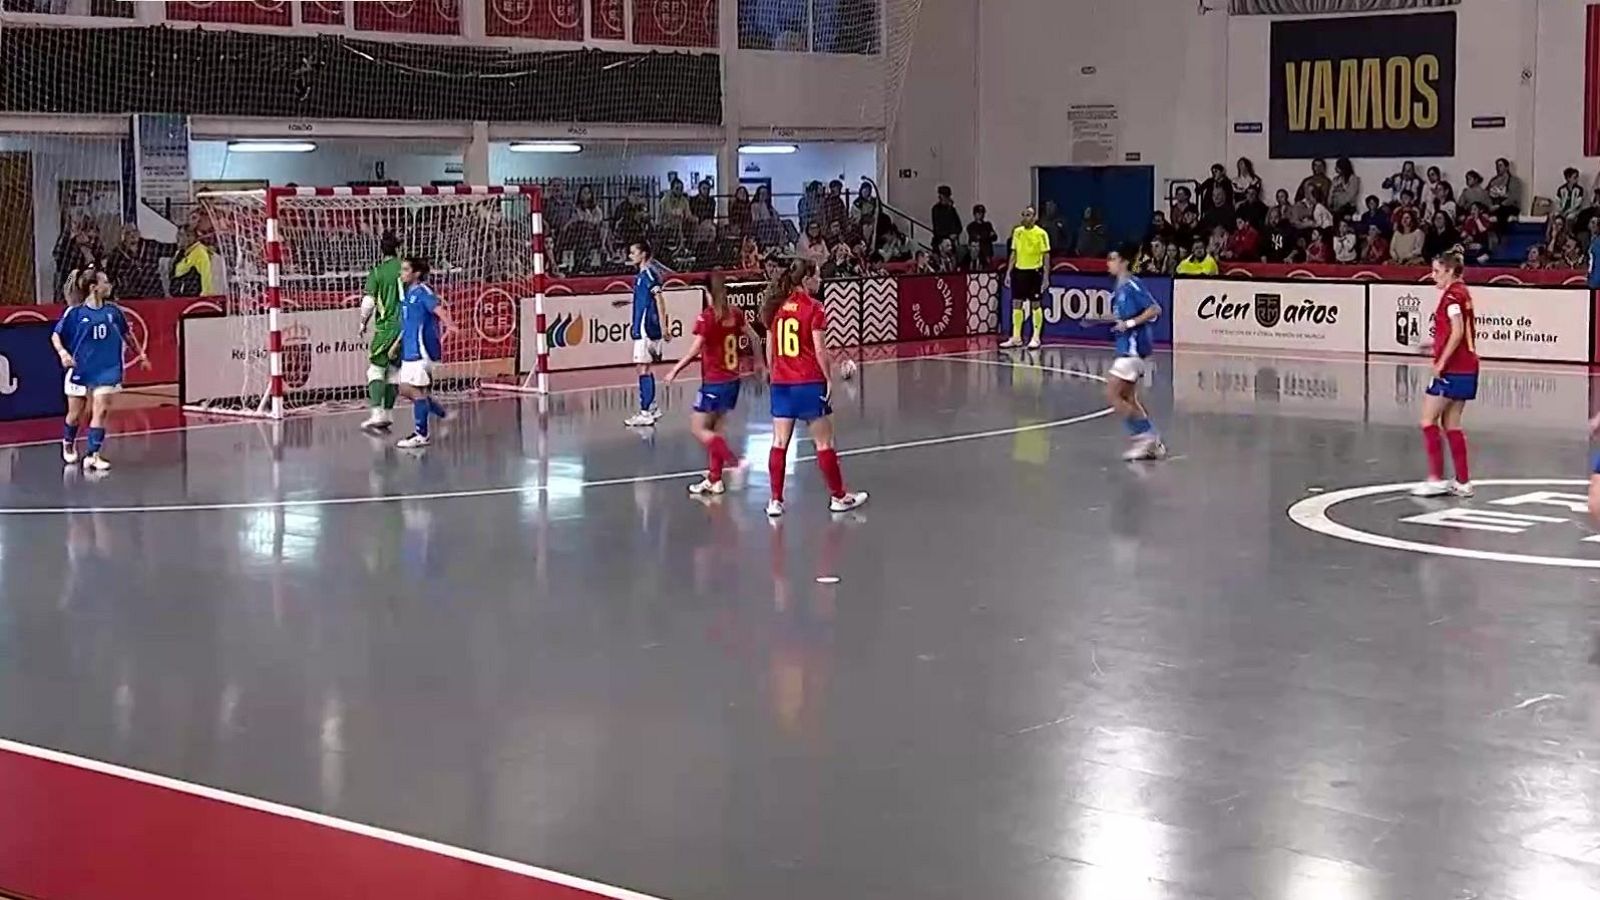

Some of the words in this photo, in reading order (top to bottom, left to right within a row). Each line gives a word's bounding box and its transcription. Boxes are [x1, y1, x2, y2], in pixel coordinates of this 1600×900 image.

[1285, 54, 1440, 131] VAMOS
[1197, 294, 1250, 320] Cien
[1283, 299, 1338, 324] años
[93, 323, 107, 340] 10
[1516, 316, 1532, 327] de
[316, 341, 331, 354] de
[777, 317, 799, 358] 16
[1492, 329, 1511, 341] del
[1514, 330, 1558, 343] Pinatar
[724, 333, 739, 370] 8
